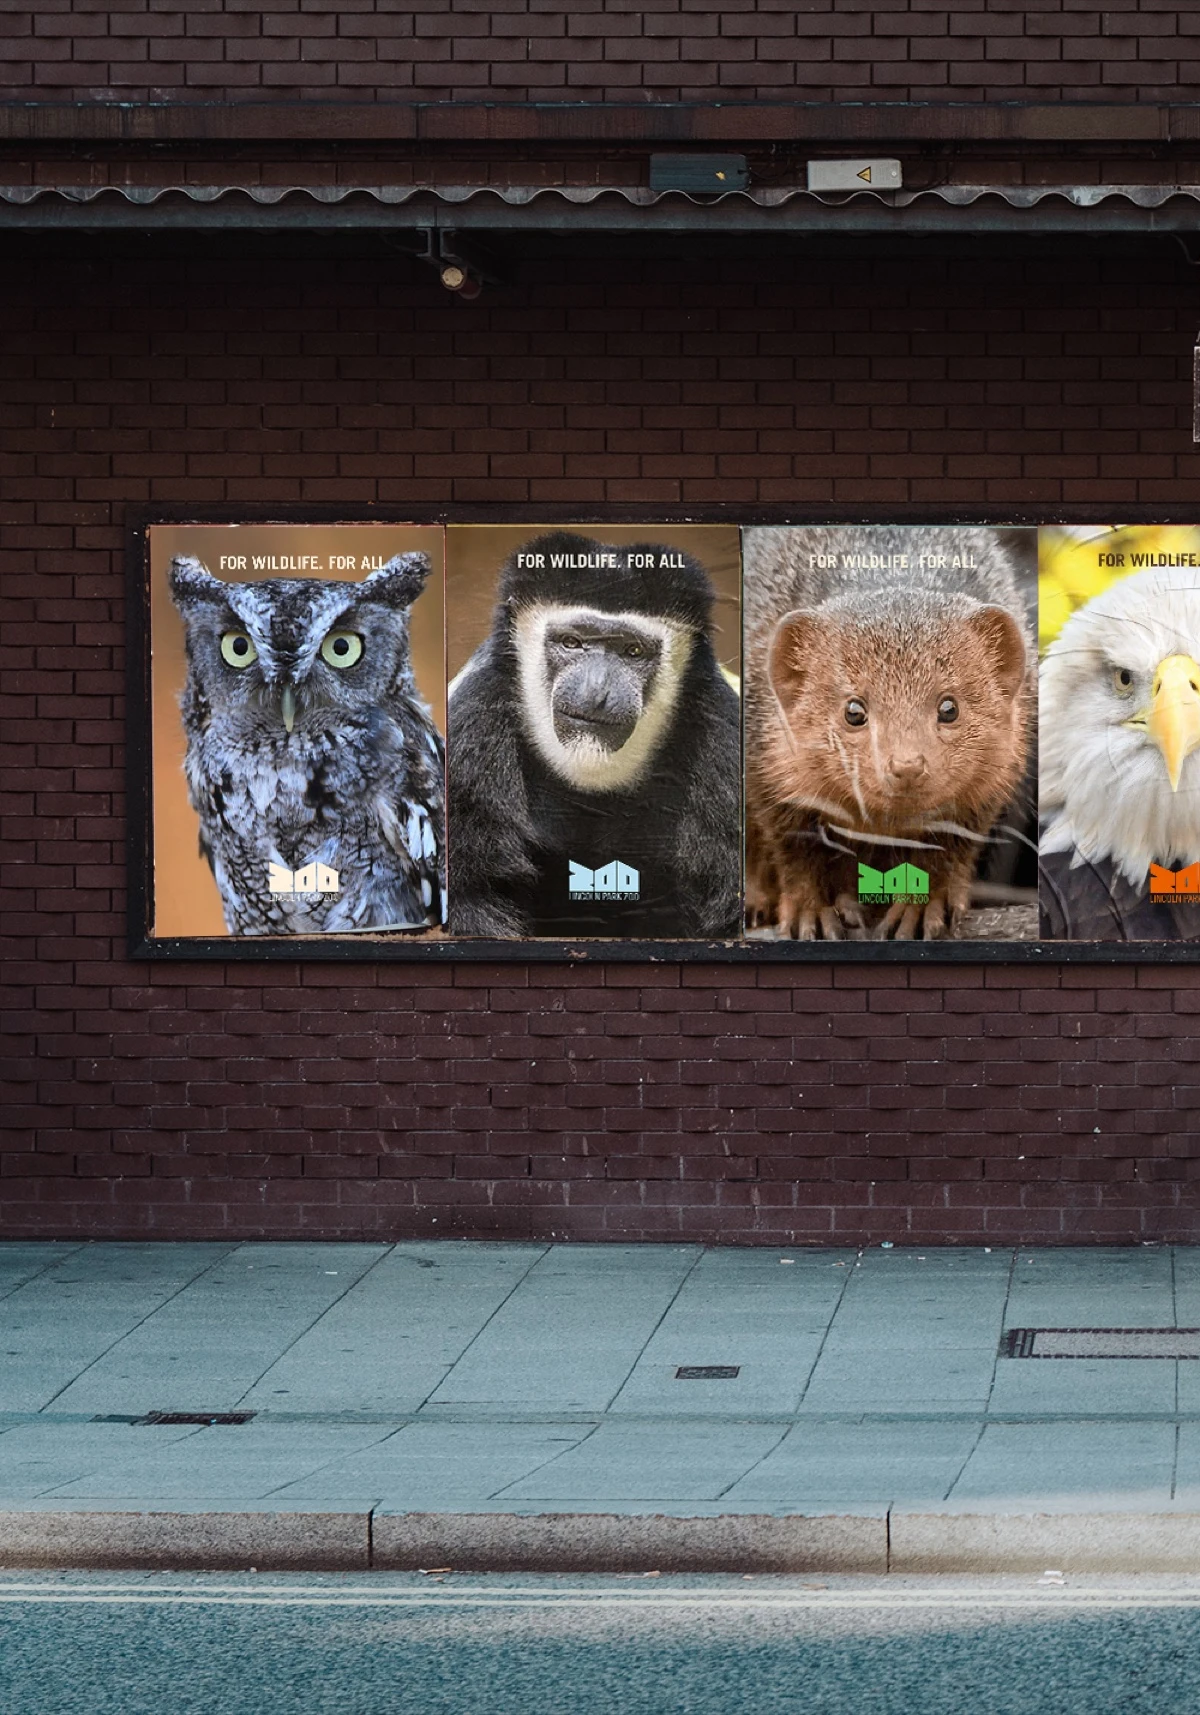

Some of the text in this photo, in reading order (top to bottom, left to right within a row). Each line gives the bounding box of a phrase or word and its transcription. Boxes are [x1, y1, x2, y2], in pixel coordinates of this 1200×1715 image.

[220, 556, 385, 570] FOR WILDLIFE. FOR ALL
[517, 554, 686, 568] FOR WILDLIFE. FOR ALL
[809, 555, 977, 569] FOR WILDLIFE. FOR ALL
[1098, 553, 1125, 567] FOR
[269, 862, 339, 892] ZOO
[569, 860, 640, 892] ZOO
[858, 862, 930, 894] ZOO
[892, 894, 911, 904] PARK
